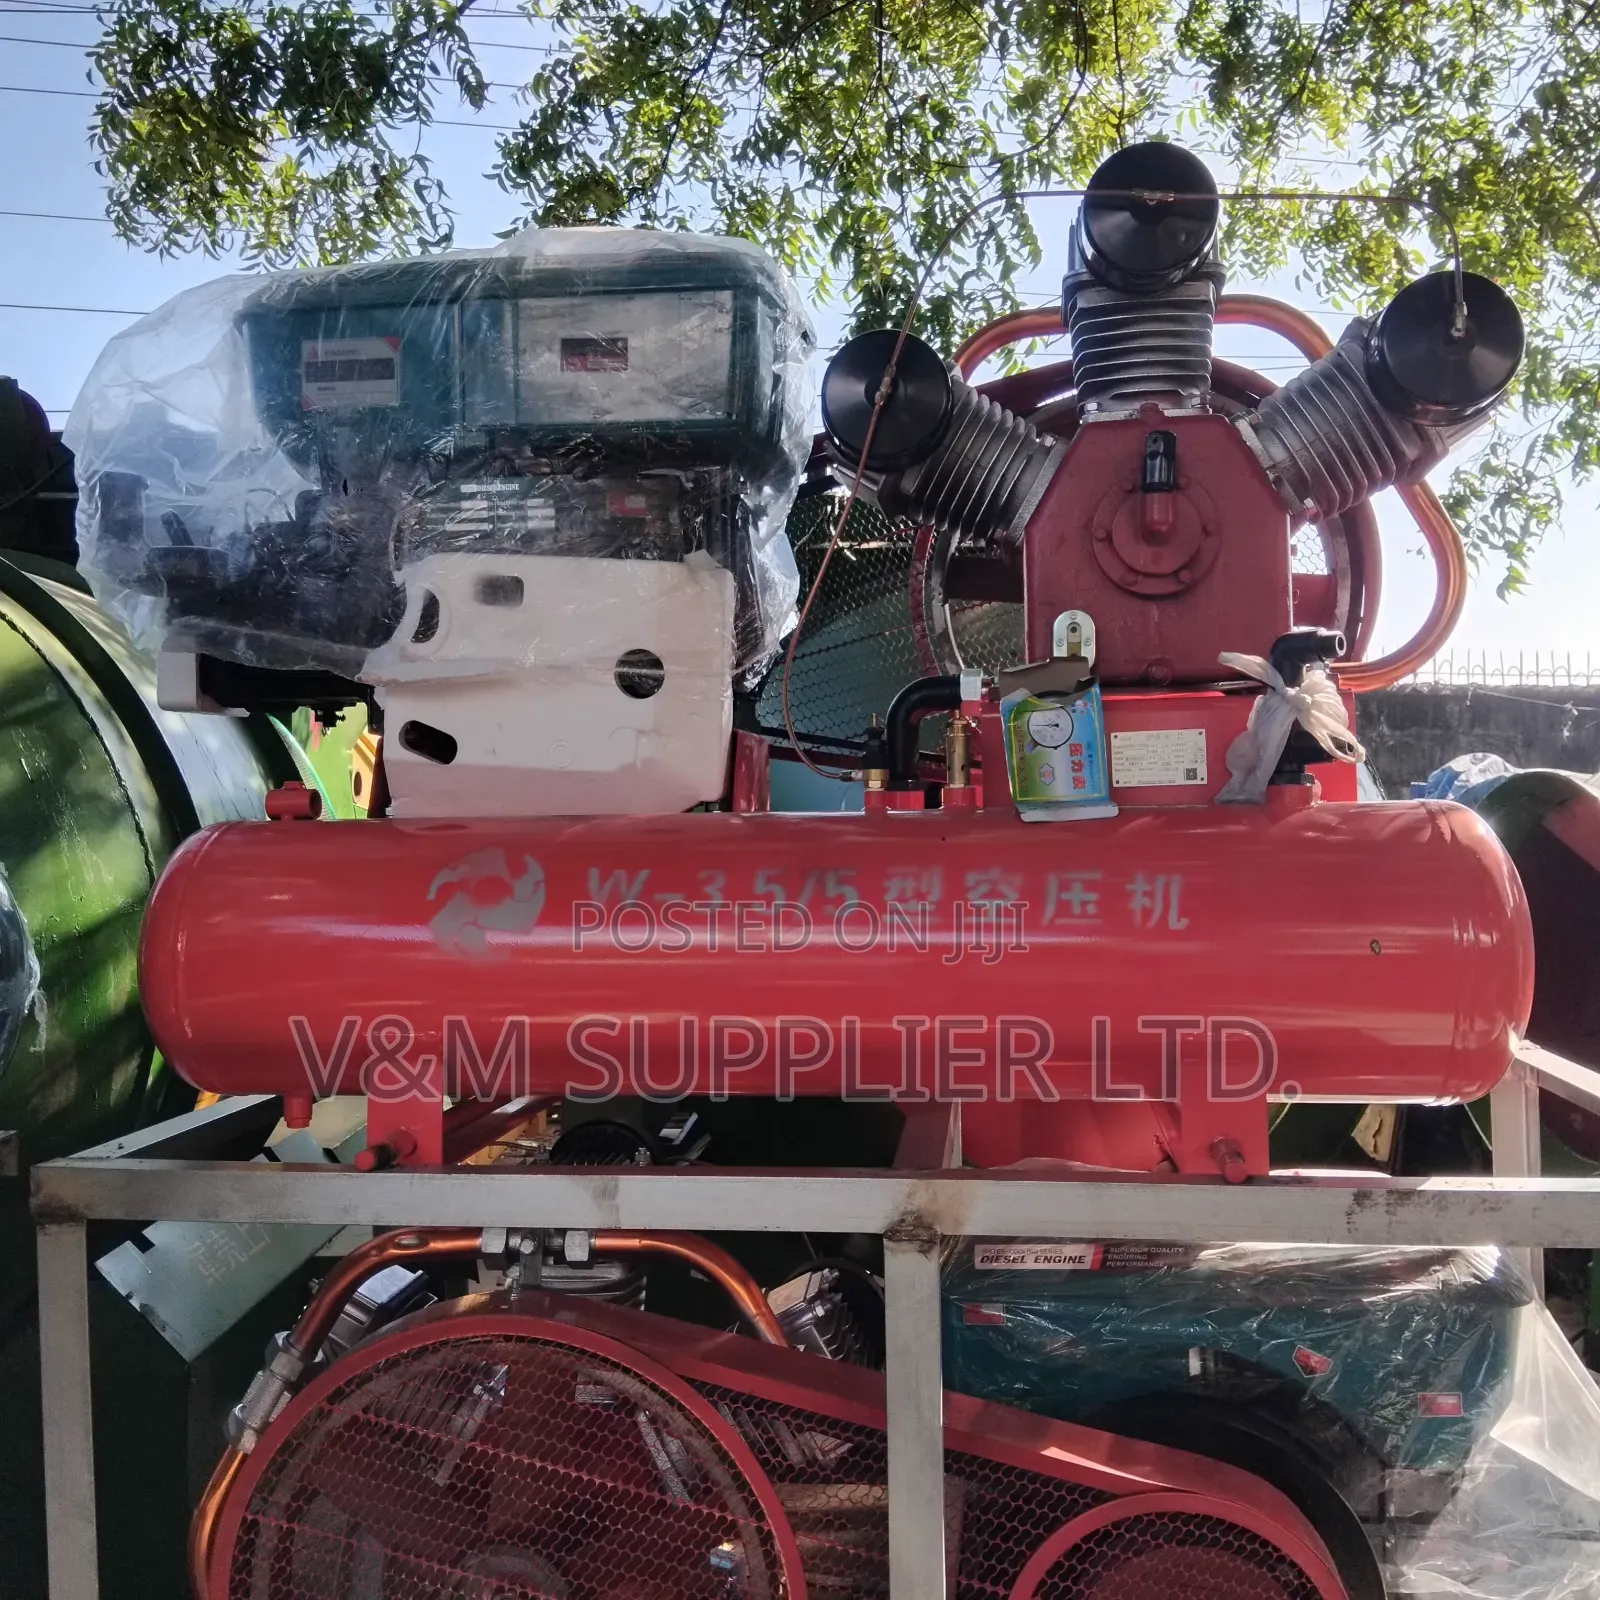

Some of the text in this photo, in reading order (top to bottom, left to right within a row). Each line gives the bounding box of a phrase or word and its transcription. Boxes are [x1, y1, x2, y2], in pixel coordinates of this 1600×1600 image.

[498, 483, 520, 491] ENGINE
[1068, 743, 1087, 790] 压力表
[980, 1255, 1087, 1264] DIESEL ENGINE
